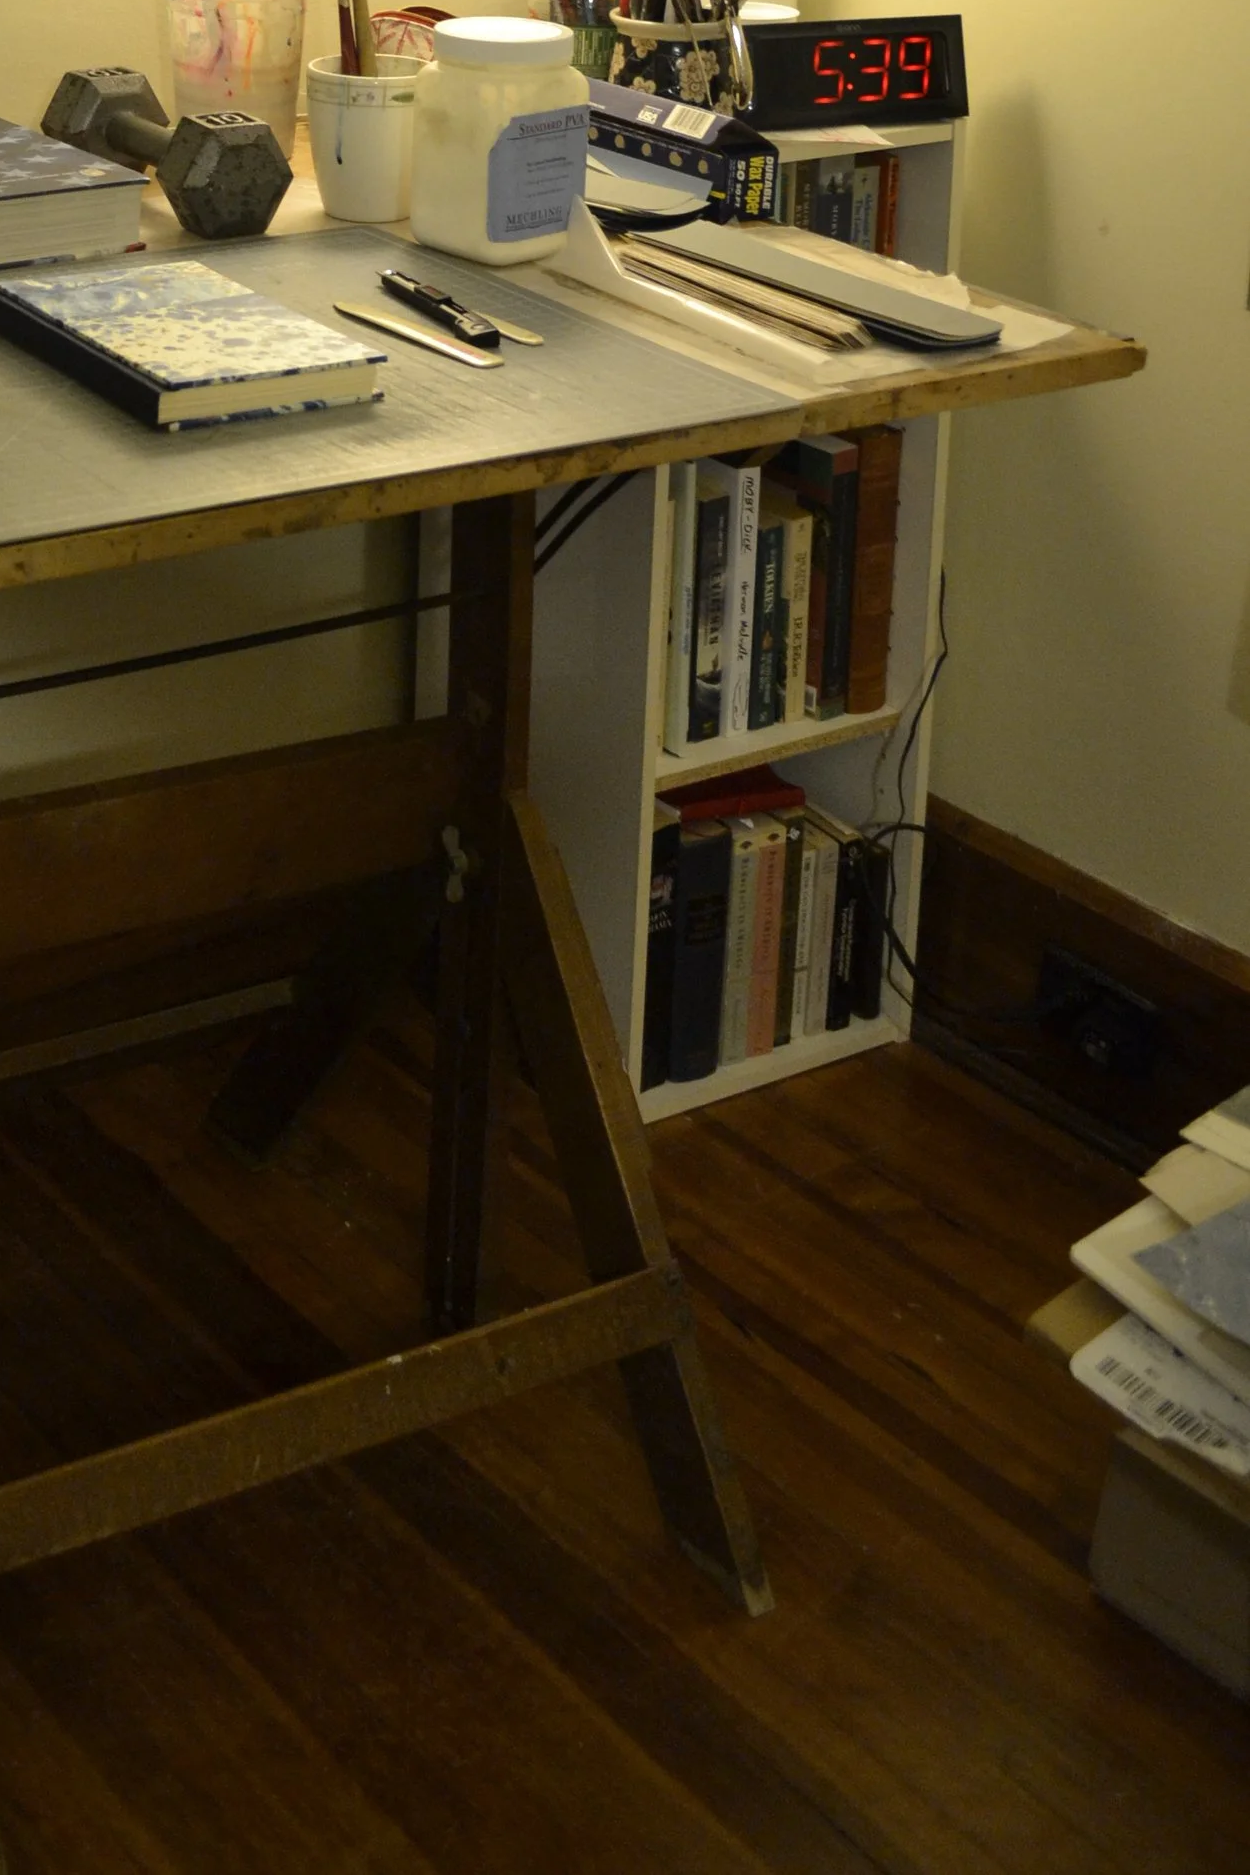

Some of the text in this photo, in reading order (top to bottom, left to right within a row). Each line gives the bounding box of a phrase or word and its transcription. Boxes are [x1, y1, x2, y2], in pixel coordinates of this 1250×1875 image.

[813, 35, 933, 105] 5:39
[207, 113, 244, 126] 10
[736, 159, 747, 182] 50
[744, 156, 765, 216] Wax Paper
[762, 156, 775, 210] DURABLE
[763, 561, 776, 615] TOLKIEN
